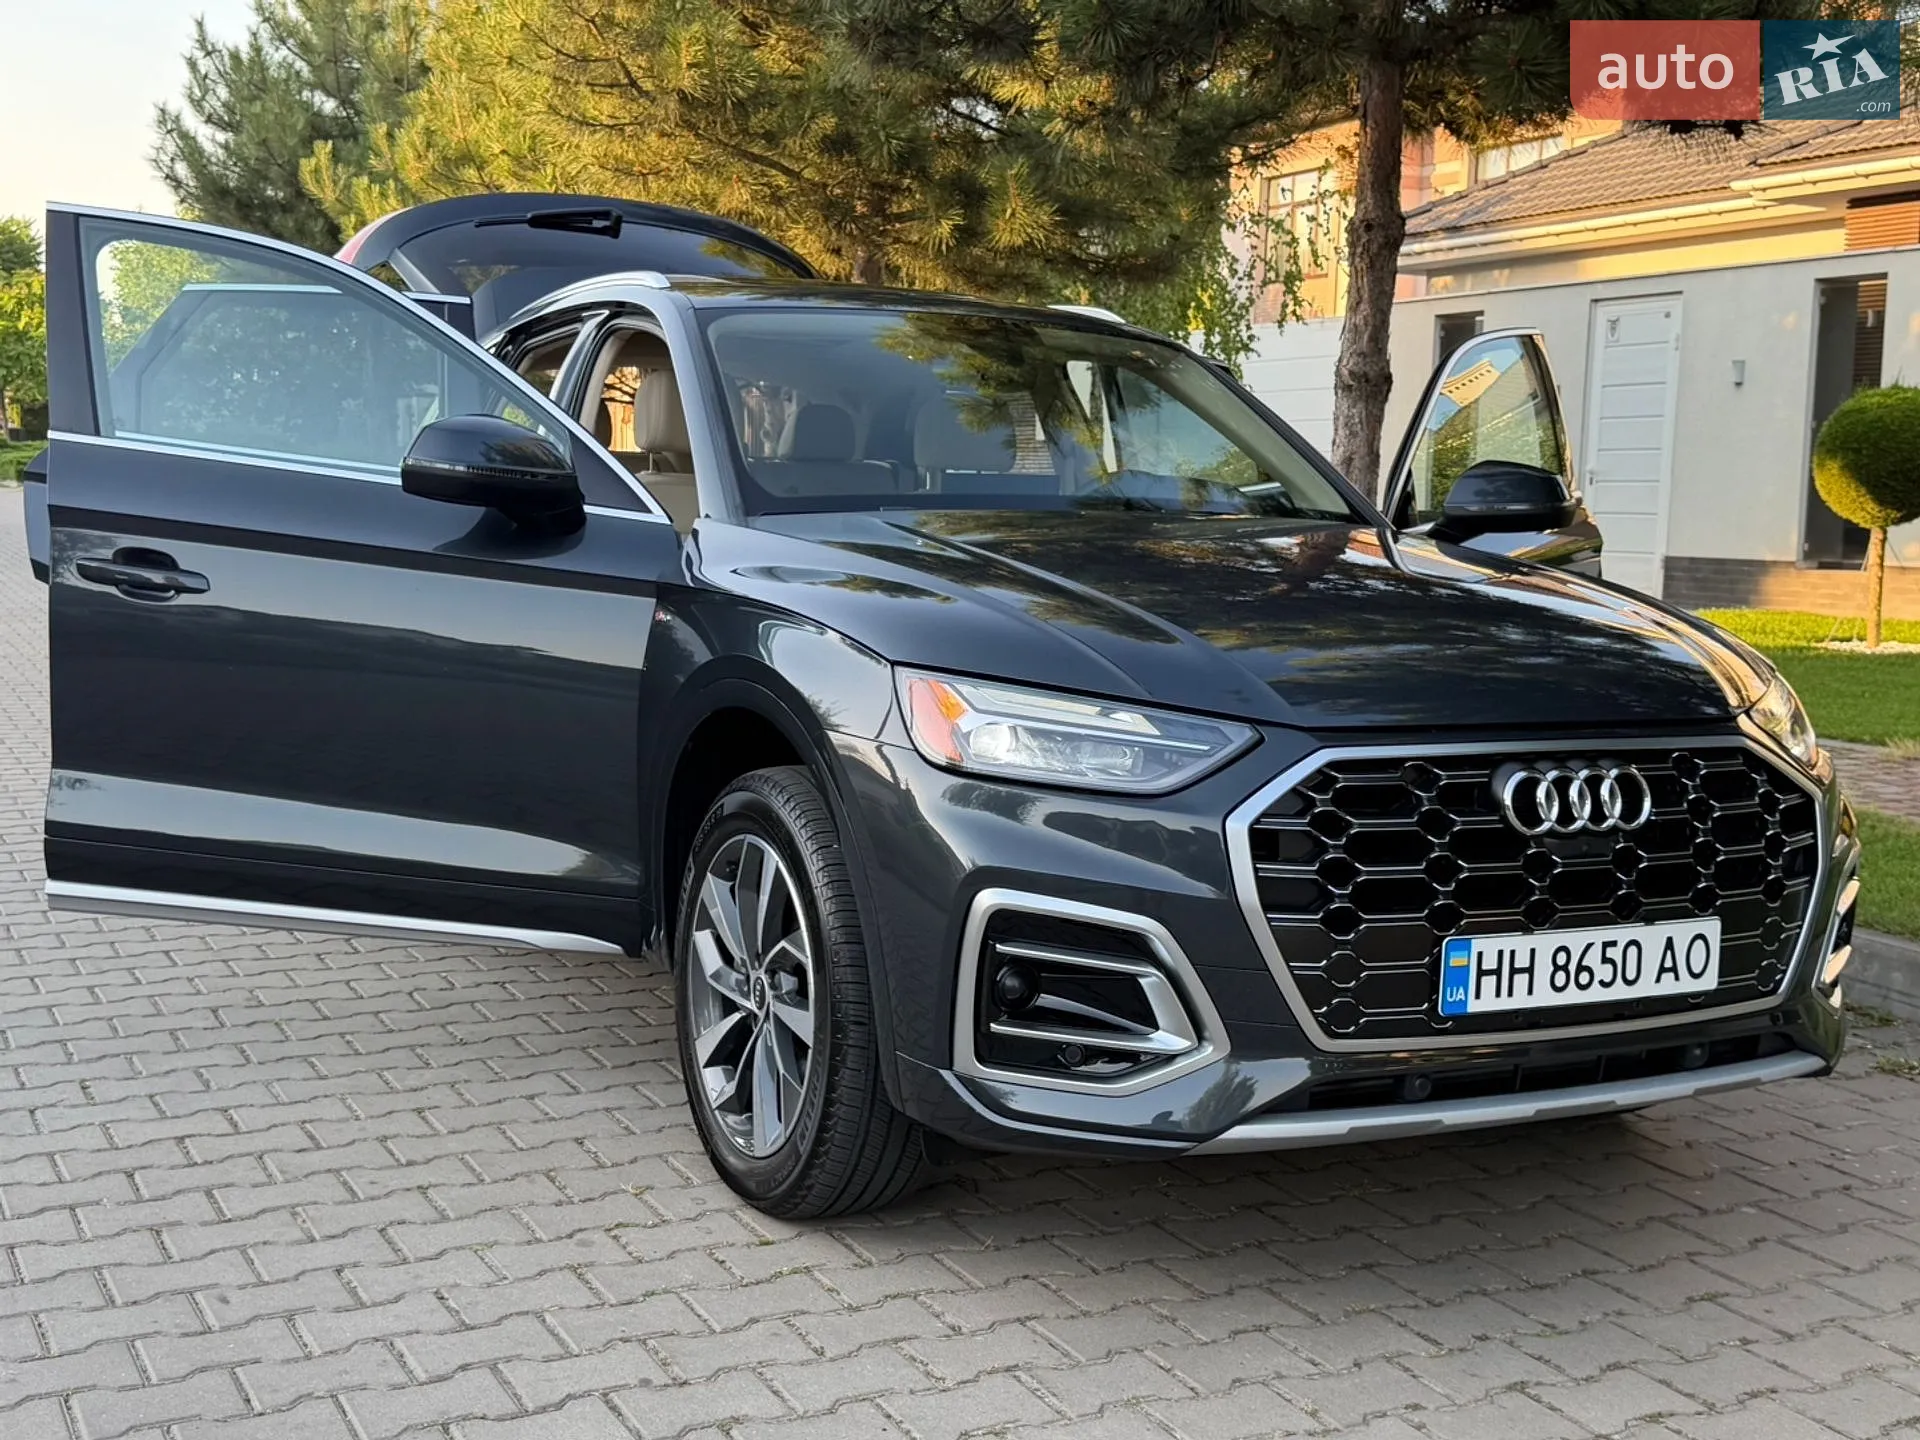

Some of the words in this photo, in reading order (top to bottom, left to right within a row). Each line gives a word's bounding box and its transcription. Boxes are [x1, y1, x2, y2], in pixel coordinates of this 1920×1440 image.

[1474, 948, 1537, 1000] HH
[1549, 938, 1643, 993] 8650
[1654, 932, 1711, 984] AO
[1446, 985, 1466, 1002] UA
